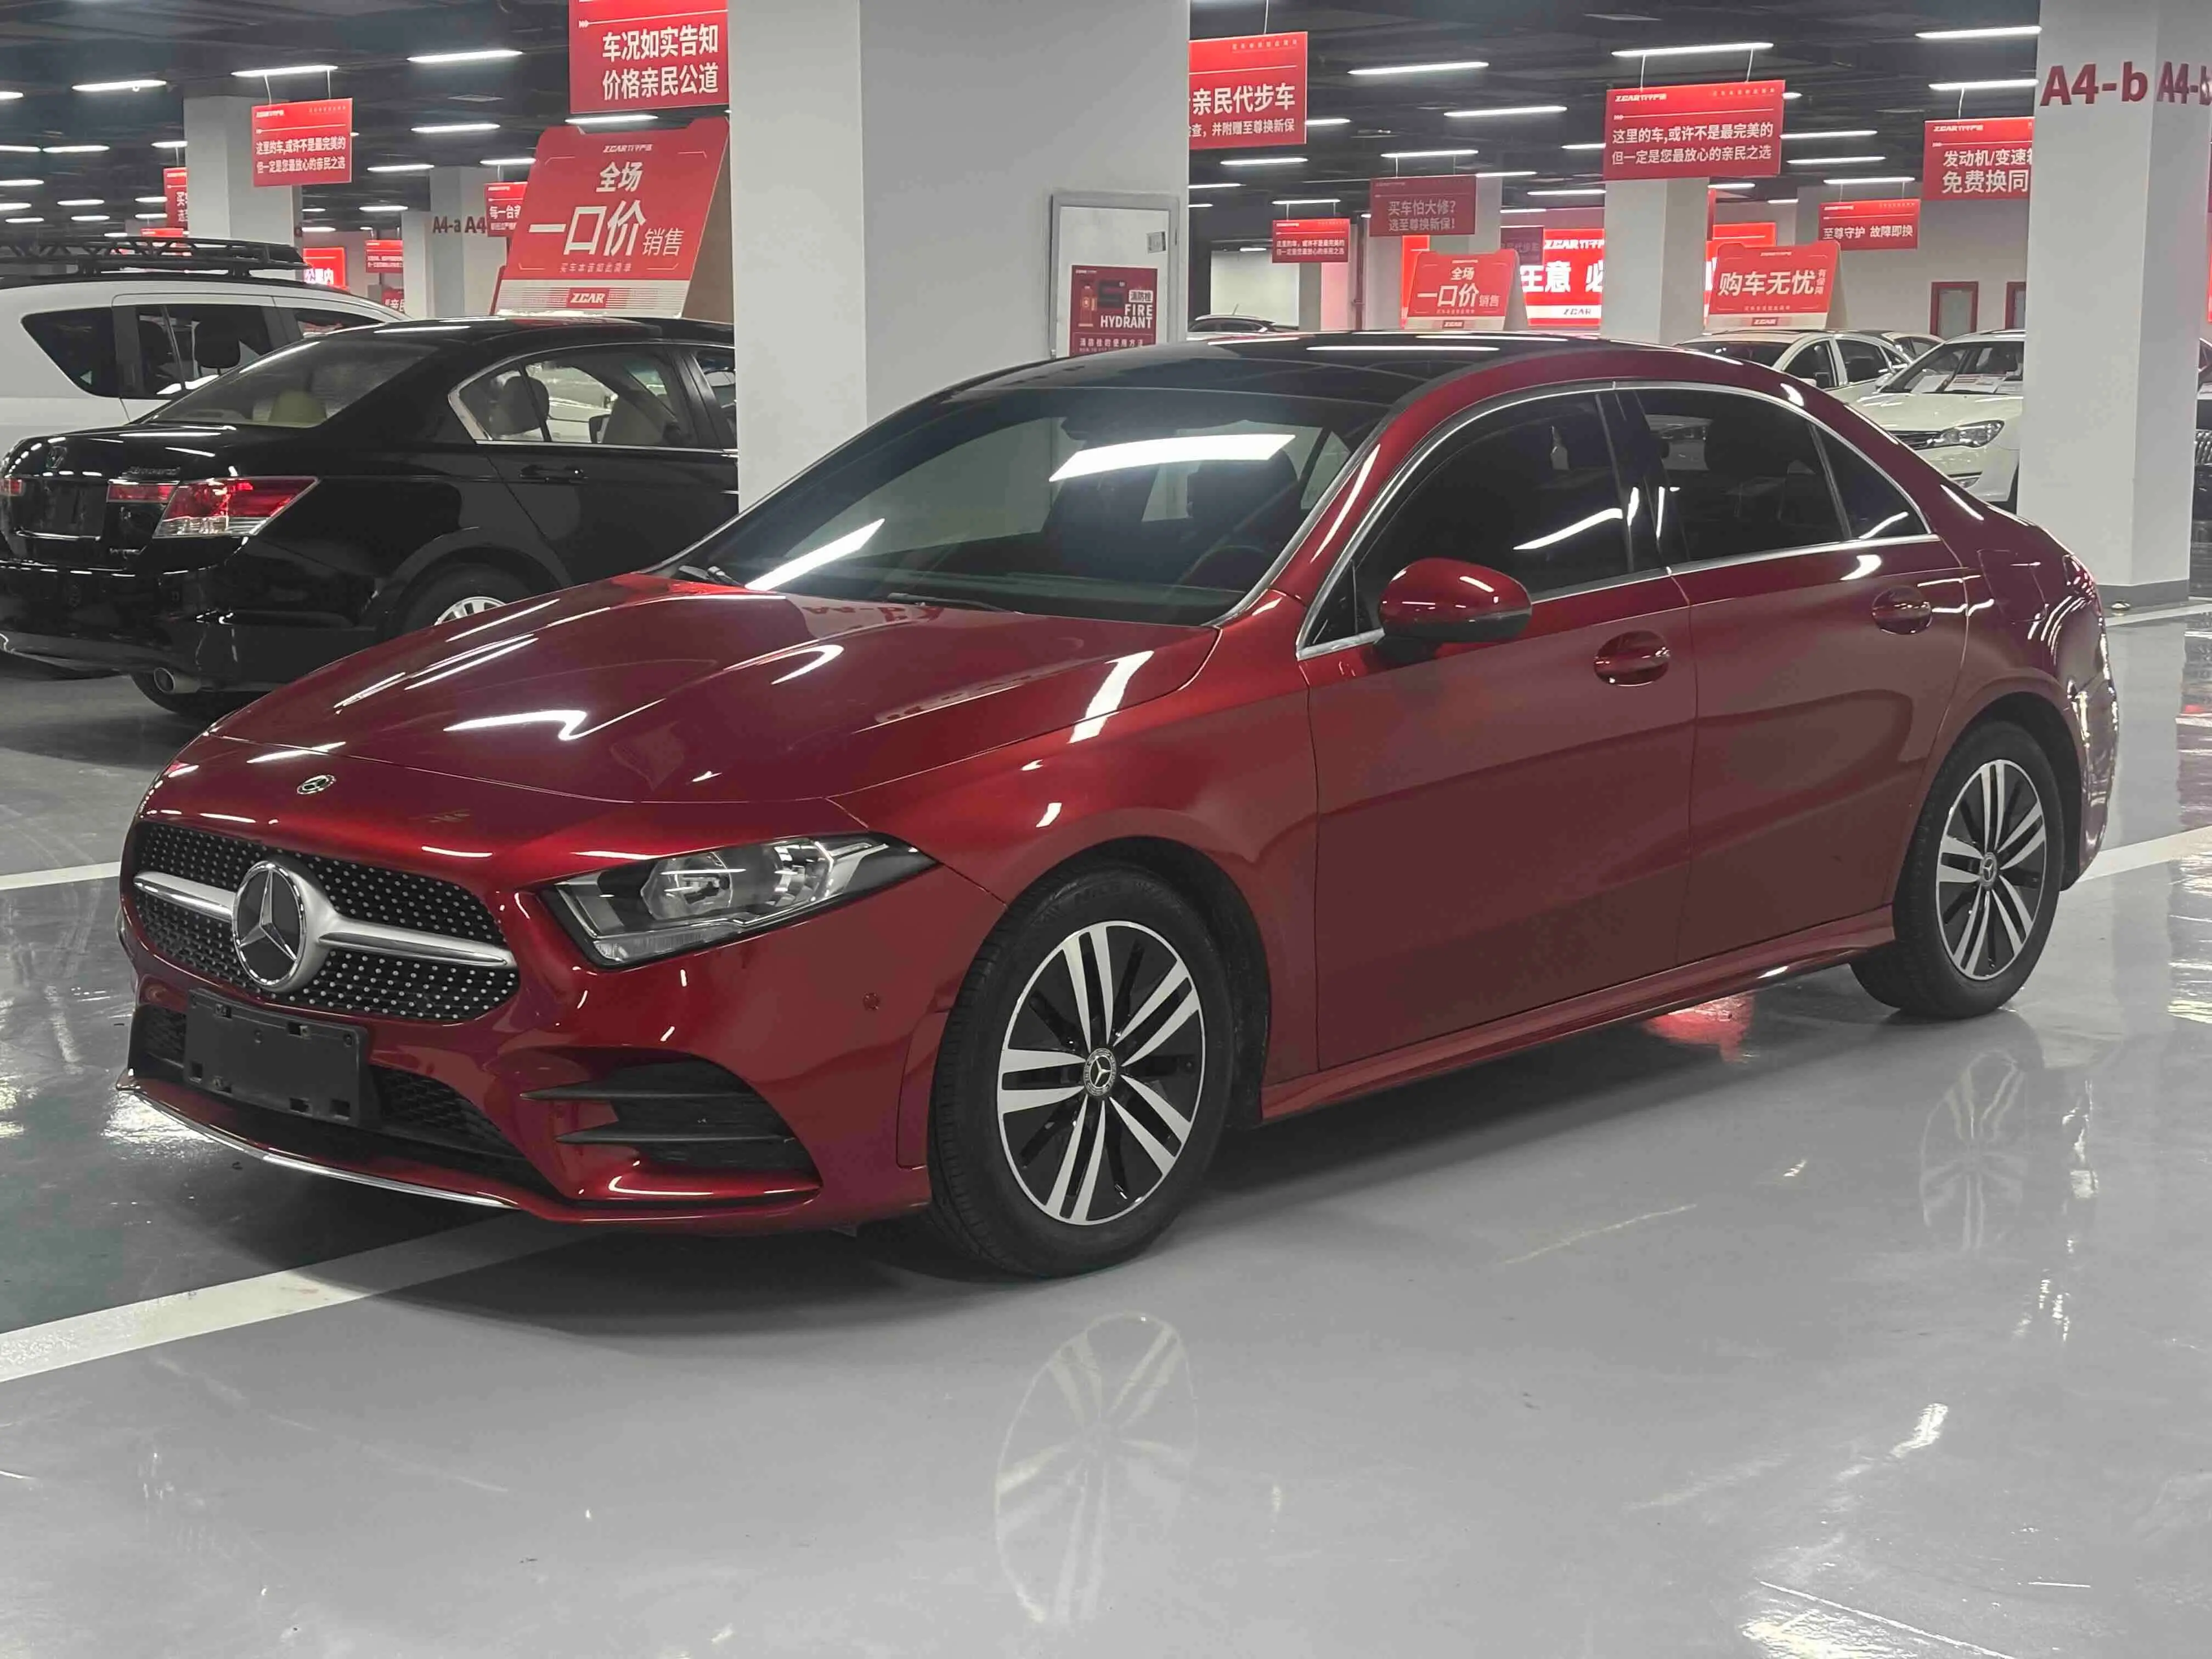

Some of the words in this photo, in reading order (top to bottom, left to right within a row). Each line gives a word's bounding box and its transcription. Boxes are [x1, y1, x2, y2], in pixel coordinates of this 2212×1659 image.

[602, 24, 718, 62] 车况如实告知
[602, 62, 719, 100] 价格亲民公道
[2040, 61, 2148, 106] A4-b
[1192, 82, 1295, 116] 亲民代步车
[1189, 118, 1295, 138] 查，并附赠至尊换新保
[1612, 144, 1772, 165] 但一定是您最放心的亲民之选
[596, 161, 644, 193] 全场
[1942, 169, 2029, 194] 免费换同
[432, 216, 461, 233] A4-a
[529, 199, 646, 256] 一口价
[642, 227, 685, 257] 销售
[1822, 227, 1866, 240] 至尊守护
[1870, 224, 1914, 238] 故障即换
[1451, 267, 1475, 281] 全场
[1718, 269, 1816, 297] 购车无忧
[569, 292, 606, 304] ZCAR
[1417, 283, 1480, 308] 一口价
[1100, 315, 1153, 329] HYDRANT
[1125, 303, 1153, 316] FIRE
